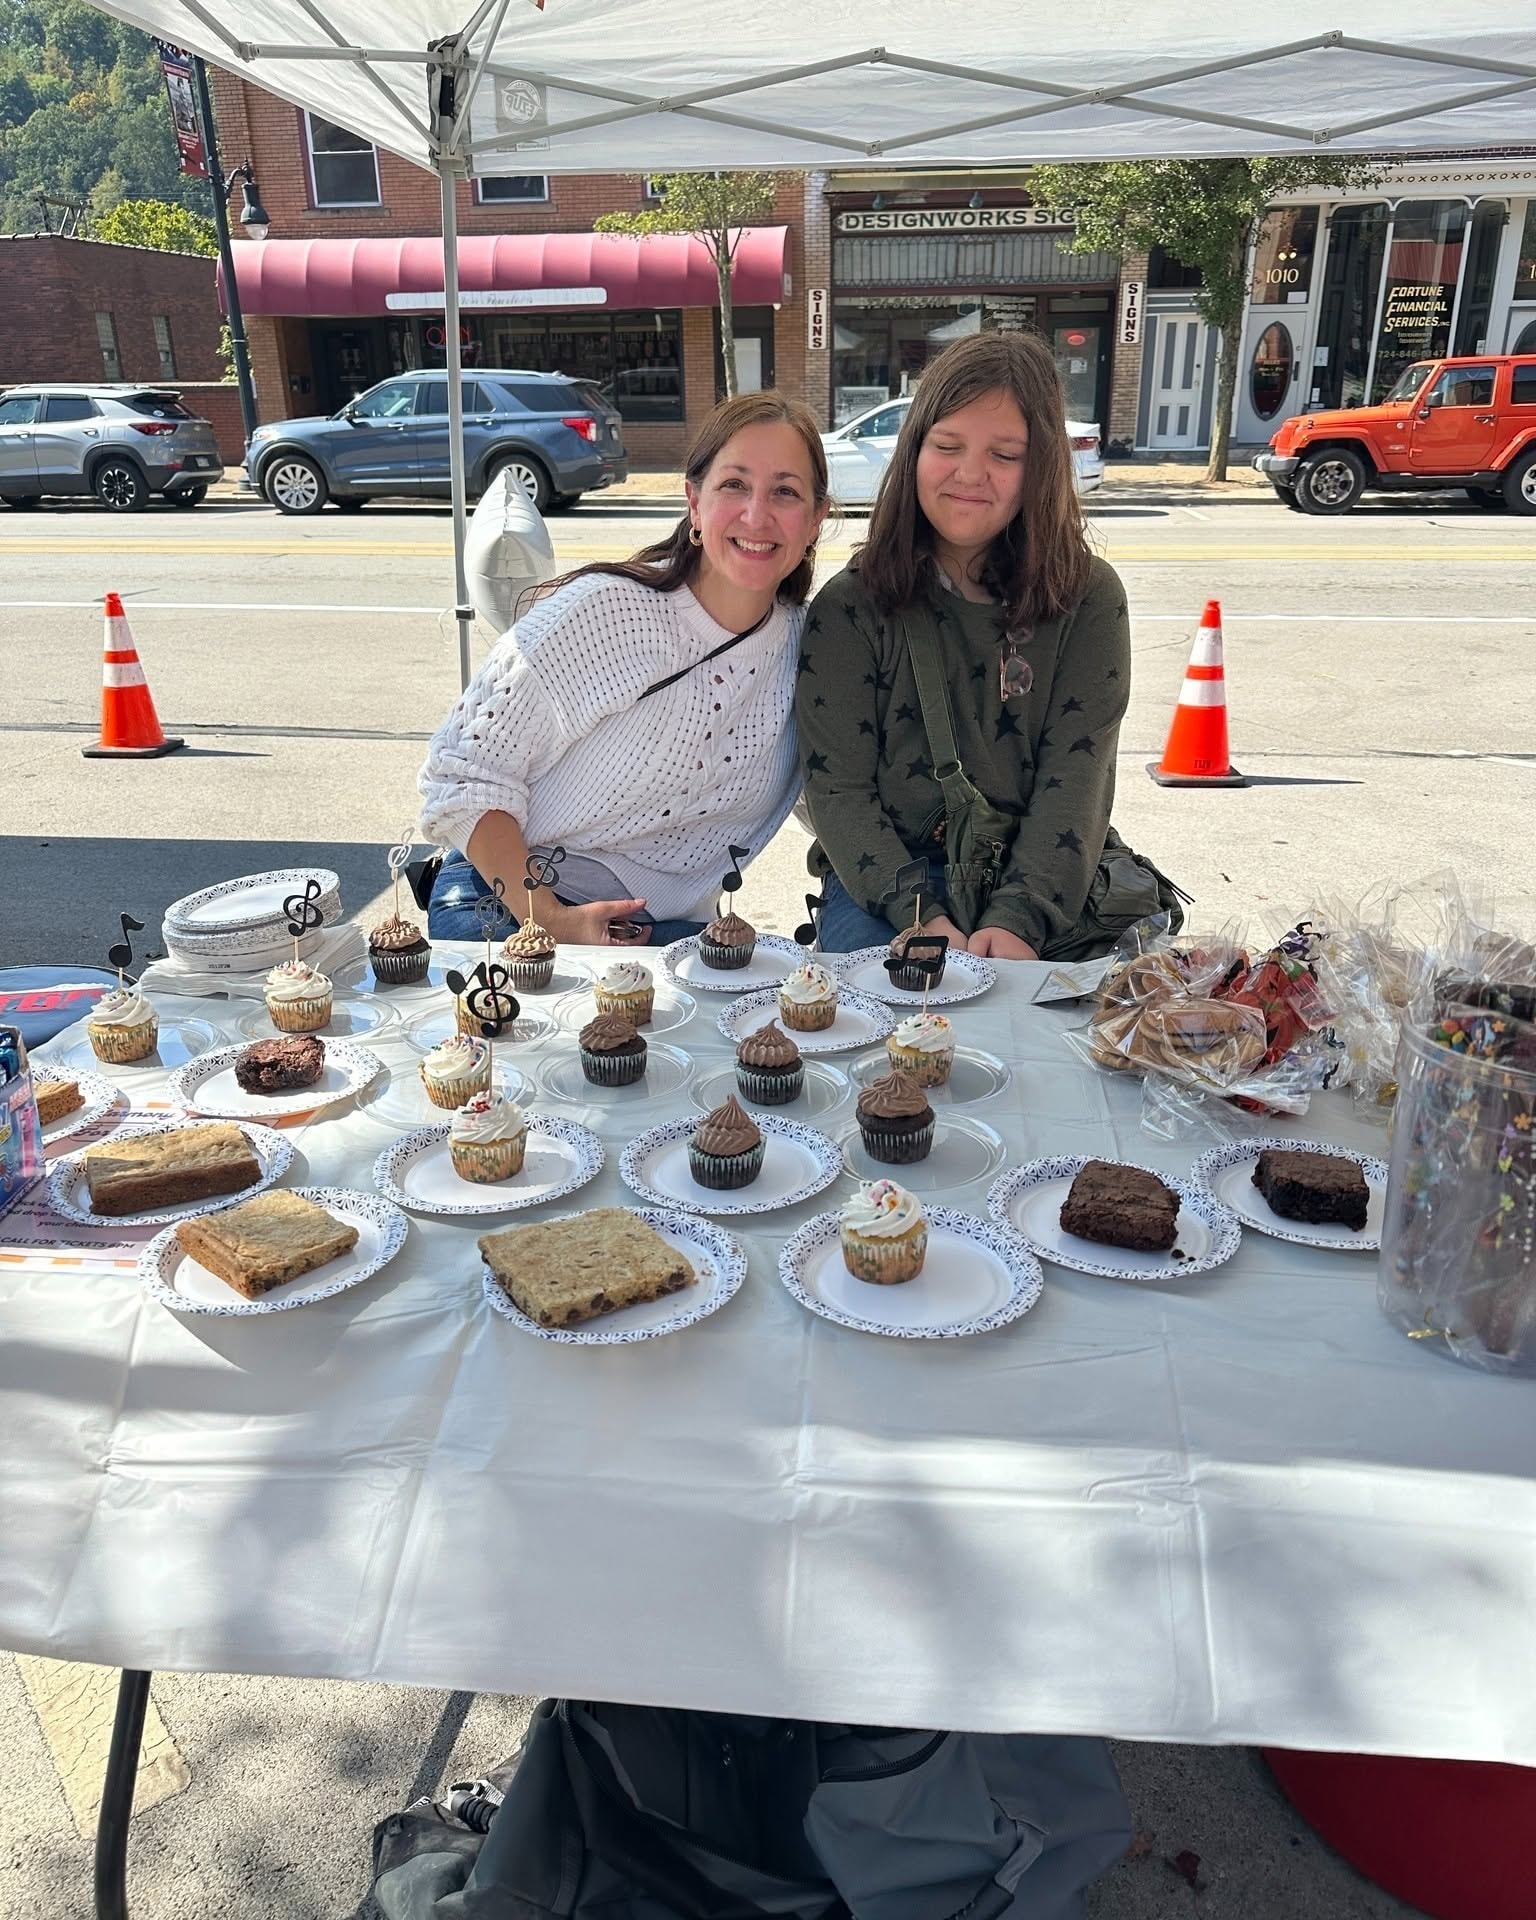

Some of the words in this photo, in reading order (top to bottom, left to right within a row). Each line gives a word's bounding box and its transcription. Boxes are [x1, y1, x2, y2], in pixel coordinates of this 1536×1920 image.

[845, 210, 1027, 229] DESIGNWORKS
[1034, 209, 1077, 225] SIG
[1265, 268, 1299, 284] 1010
[1387, 286, 1444, 302] FORTUNE
[1124, 283, 1138, 342] SIGNS
[1385, 301, 1448, 317] FINANCIAL
[812, 290, 823, 348] SIGNS
[60, 1239, 107, 1248] TICKETS
